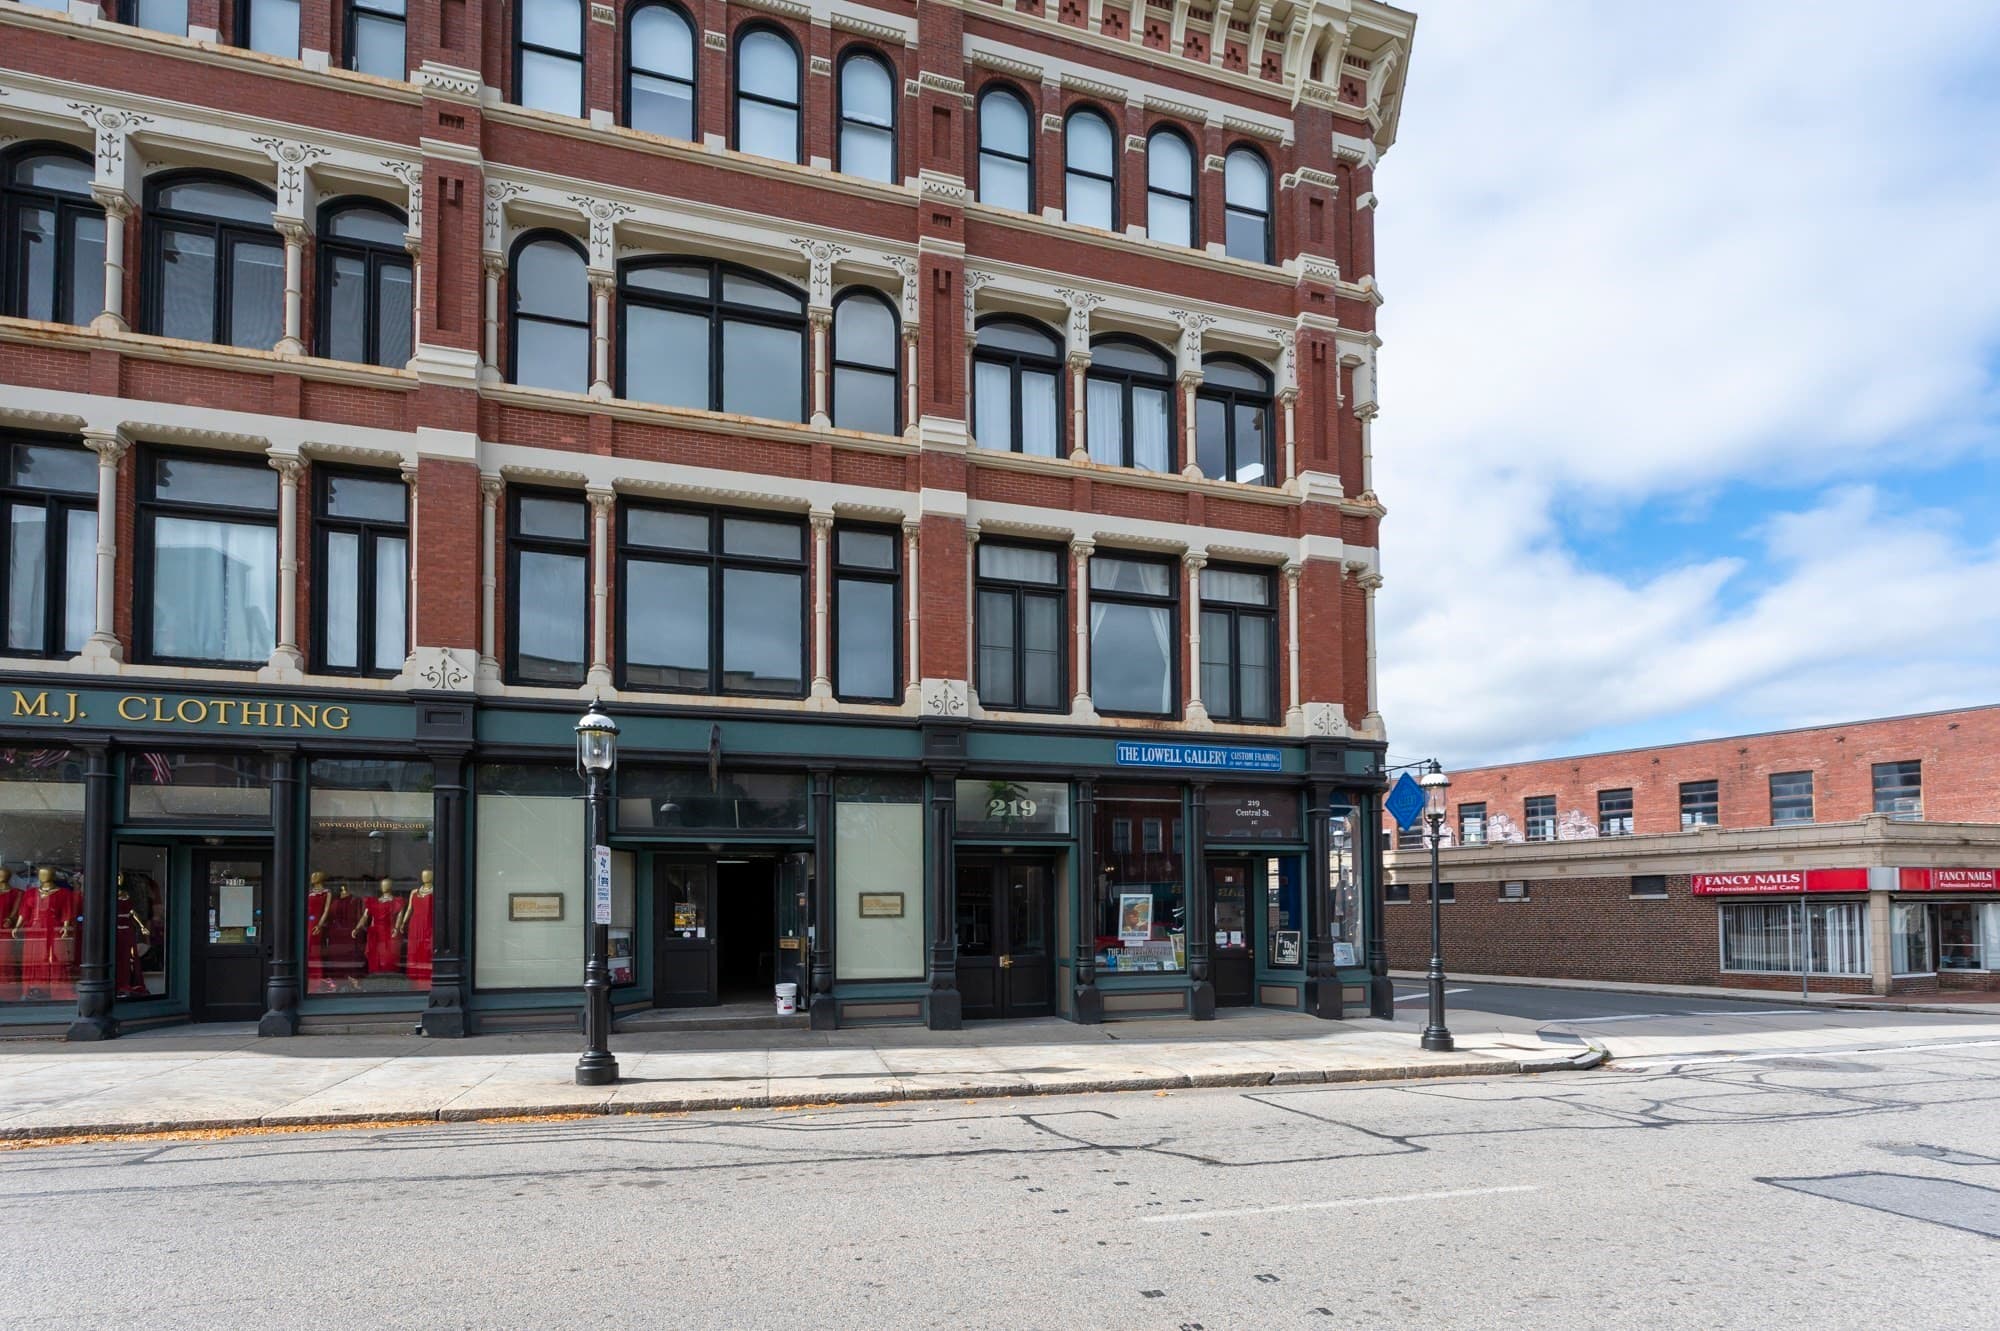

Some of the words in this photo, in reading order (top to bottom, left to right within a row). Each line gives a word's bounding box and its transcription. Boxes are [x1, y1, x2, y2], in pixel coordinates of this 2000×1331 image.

[11, 690, 88, 724] M.J.
[117, 695, 351, 730] CLOTHING
[1119, 746, 1140, 762] THE
[1141, 747, 1183, 764] LOWELL
[1184, 749, 1228, 765] GALLERY
[1230, 751, 1254, 761] CUSTOM
[1254, 752, 1280, 763] FRAMING
[990, 799, 1037, 817] 219
[1235, 809, 1261, 817] Central
[1262, 809, 1272, 817] St.
[318, 821, 425, 830] www.mjclothings.com
[1705, 874, 1751, 886] FANCY
[1755, 873, 1801, 885] NAILS
[1939, 871, 1966, 881] FANCY
[1967, 871, 1993, 881] NAILS
[1706, 885, 1757, 893] Professional
